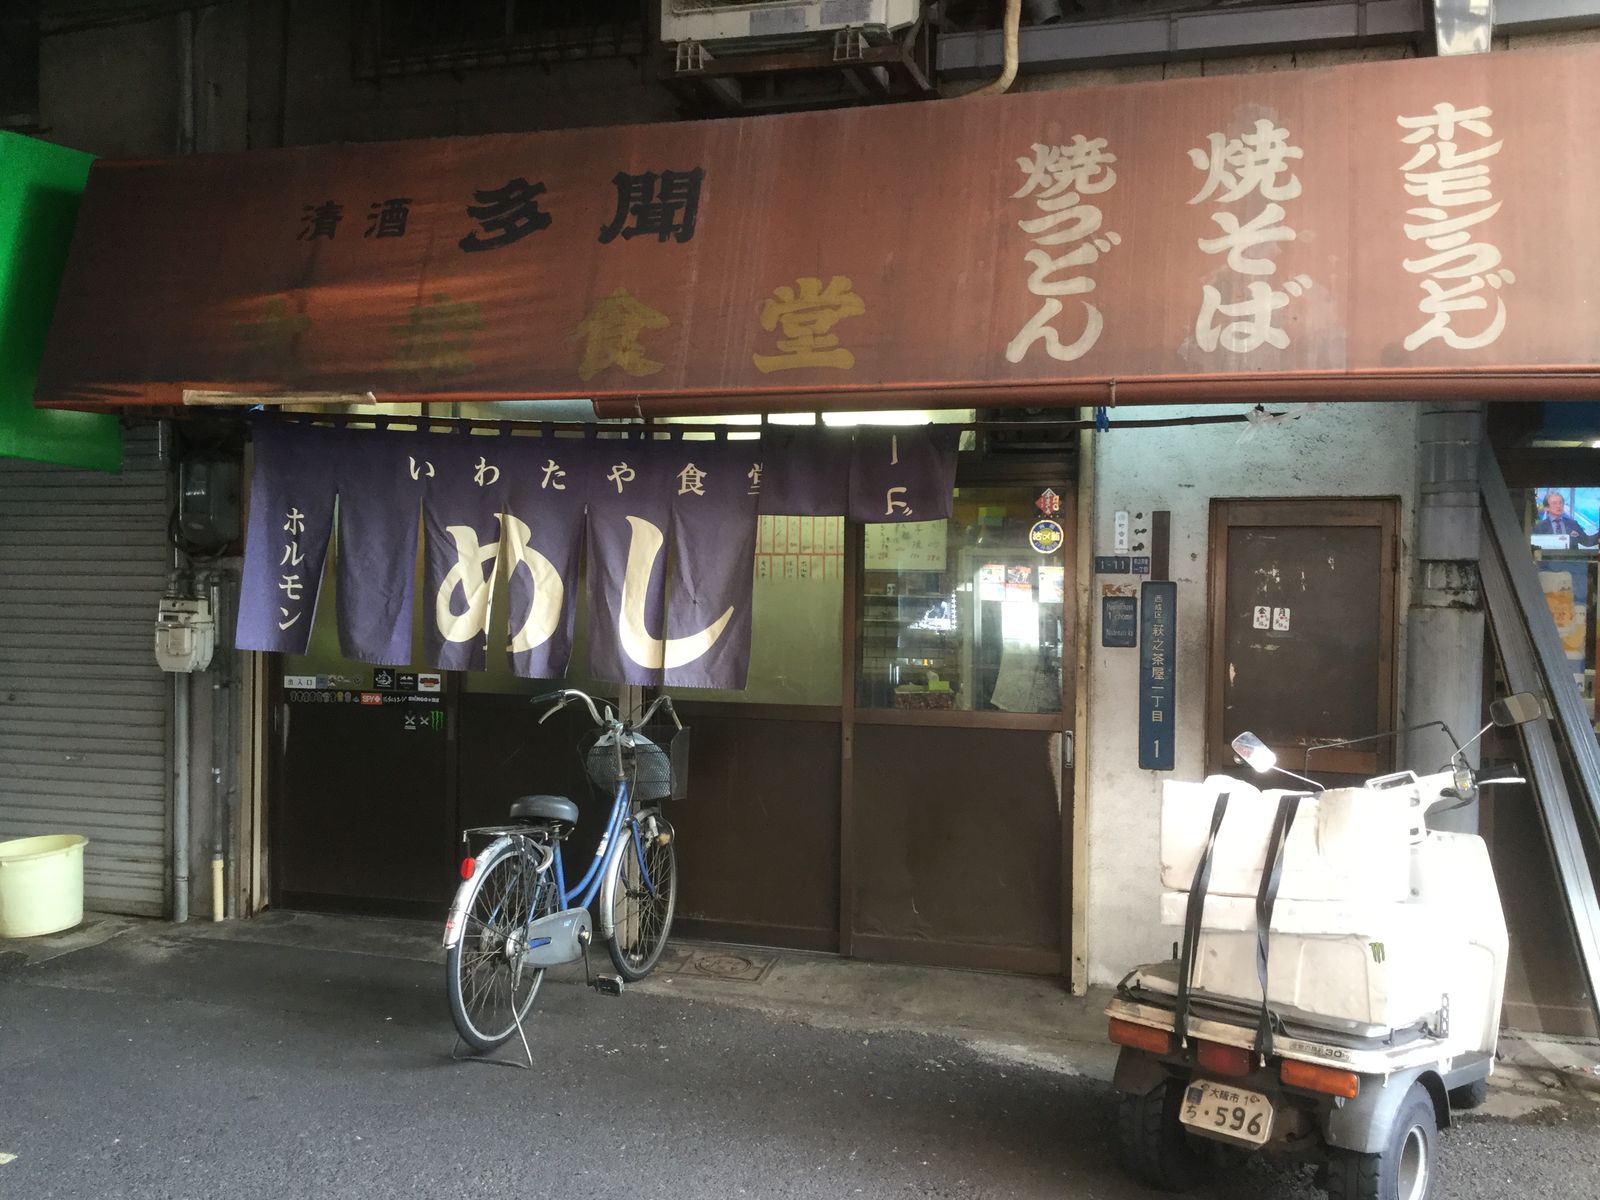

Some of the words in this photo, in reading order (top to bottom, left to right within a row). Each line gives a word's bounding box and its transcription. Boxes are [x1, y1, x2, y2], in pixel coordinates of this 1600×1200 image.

[296, 197, 412, 241] 清酒
[458, 167, 706, 252] 多聞
[1007, 134, 1121, 363] 焼うどん
[1187, 119, 1312, 353] 焼そば
[1397, 102, 1516, 352] ホルモンうどん
[278, 507, 305, 631] ホルモン
[435, 513, 734, 669] めし
[1209, 1088, 1240, 1103] 大阪市
